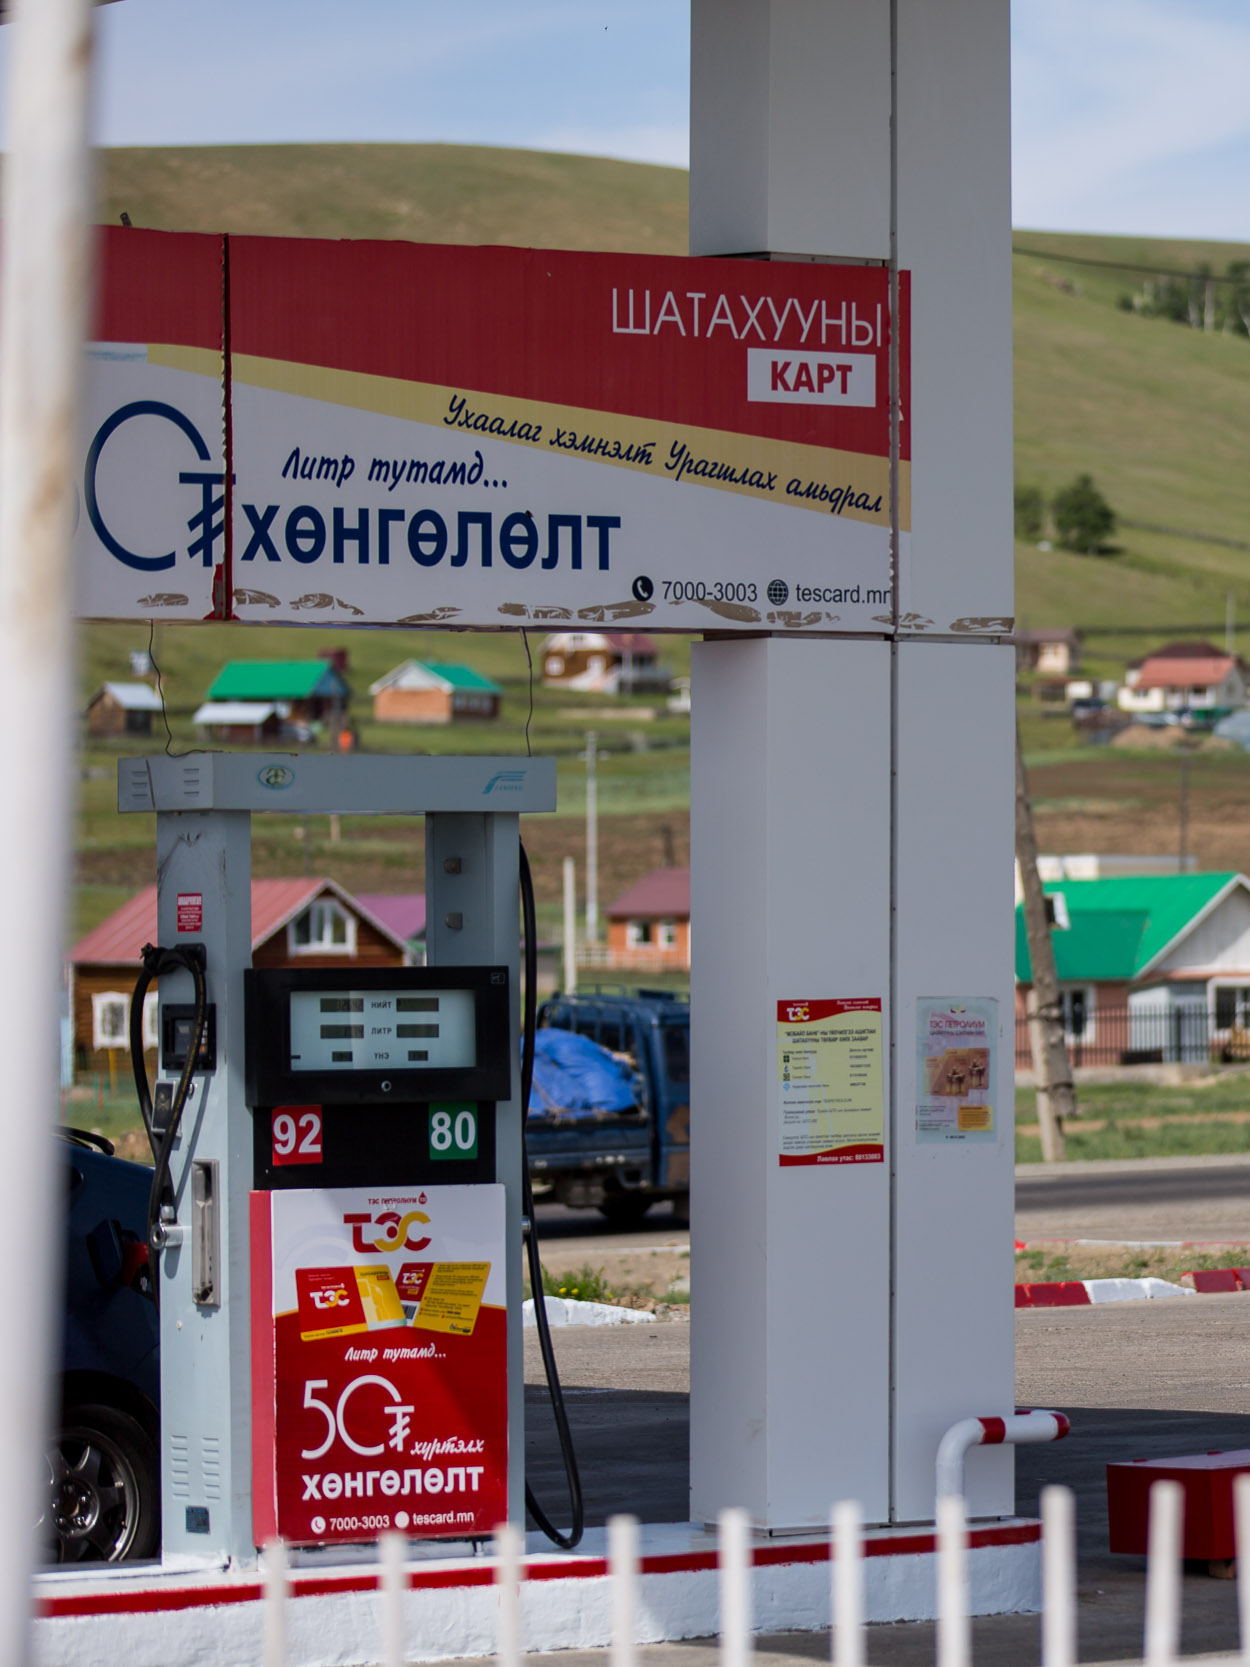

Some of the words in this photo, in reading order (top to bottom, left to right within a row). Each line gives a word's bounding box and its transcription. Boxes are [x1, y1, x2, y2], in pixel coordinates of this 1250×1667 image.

[612, 287, 882, 347] ШАТАХУУНЫ
[770, 360, 853, 395] КАРТ
[282, 446, 355, 488] Литр
[443, 394, 542, 442] Ухаалаг
[549, 428, 656, 465] хэмнэлт
[664, 440, 778, 491] Урагшлах
[786, 478, 883, 515] амьдрал
[240, 503, 622, 571] ХӨНГӨЛӨЛТ
[662, 581, 758, 602] 7000-3003
[371, 1001, 392, 1009] НИЙТ
[371, 1027, 392, 1035] ЛИТР
[374, 1052, 389, 1060] ҮНЭ
[273, 1113, 322, 1155] 92
[430, 1111, 476, 1151] 80
[344, 1346, 378, 1363] Литр
[410, 1436, 485, 1461] хүртэлх
[302, 1466, 485, 1500] ХӨНГӨЛӨЛТ
[330, 1514, 390, 1530] 7000-3003
[413, 1510, 475, 1525] tescard.mn
